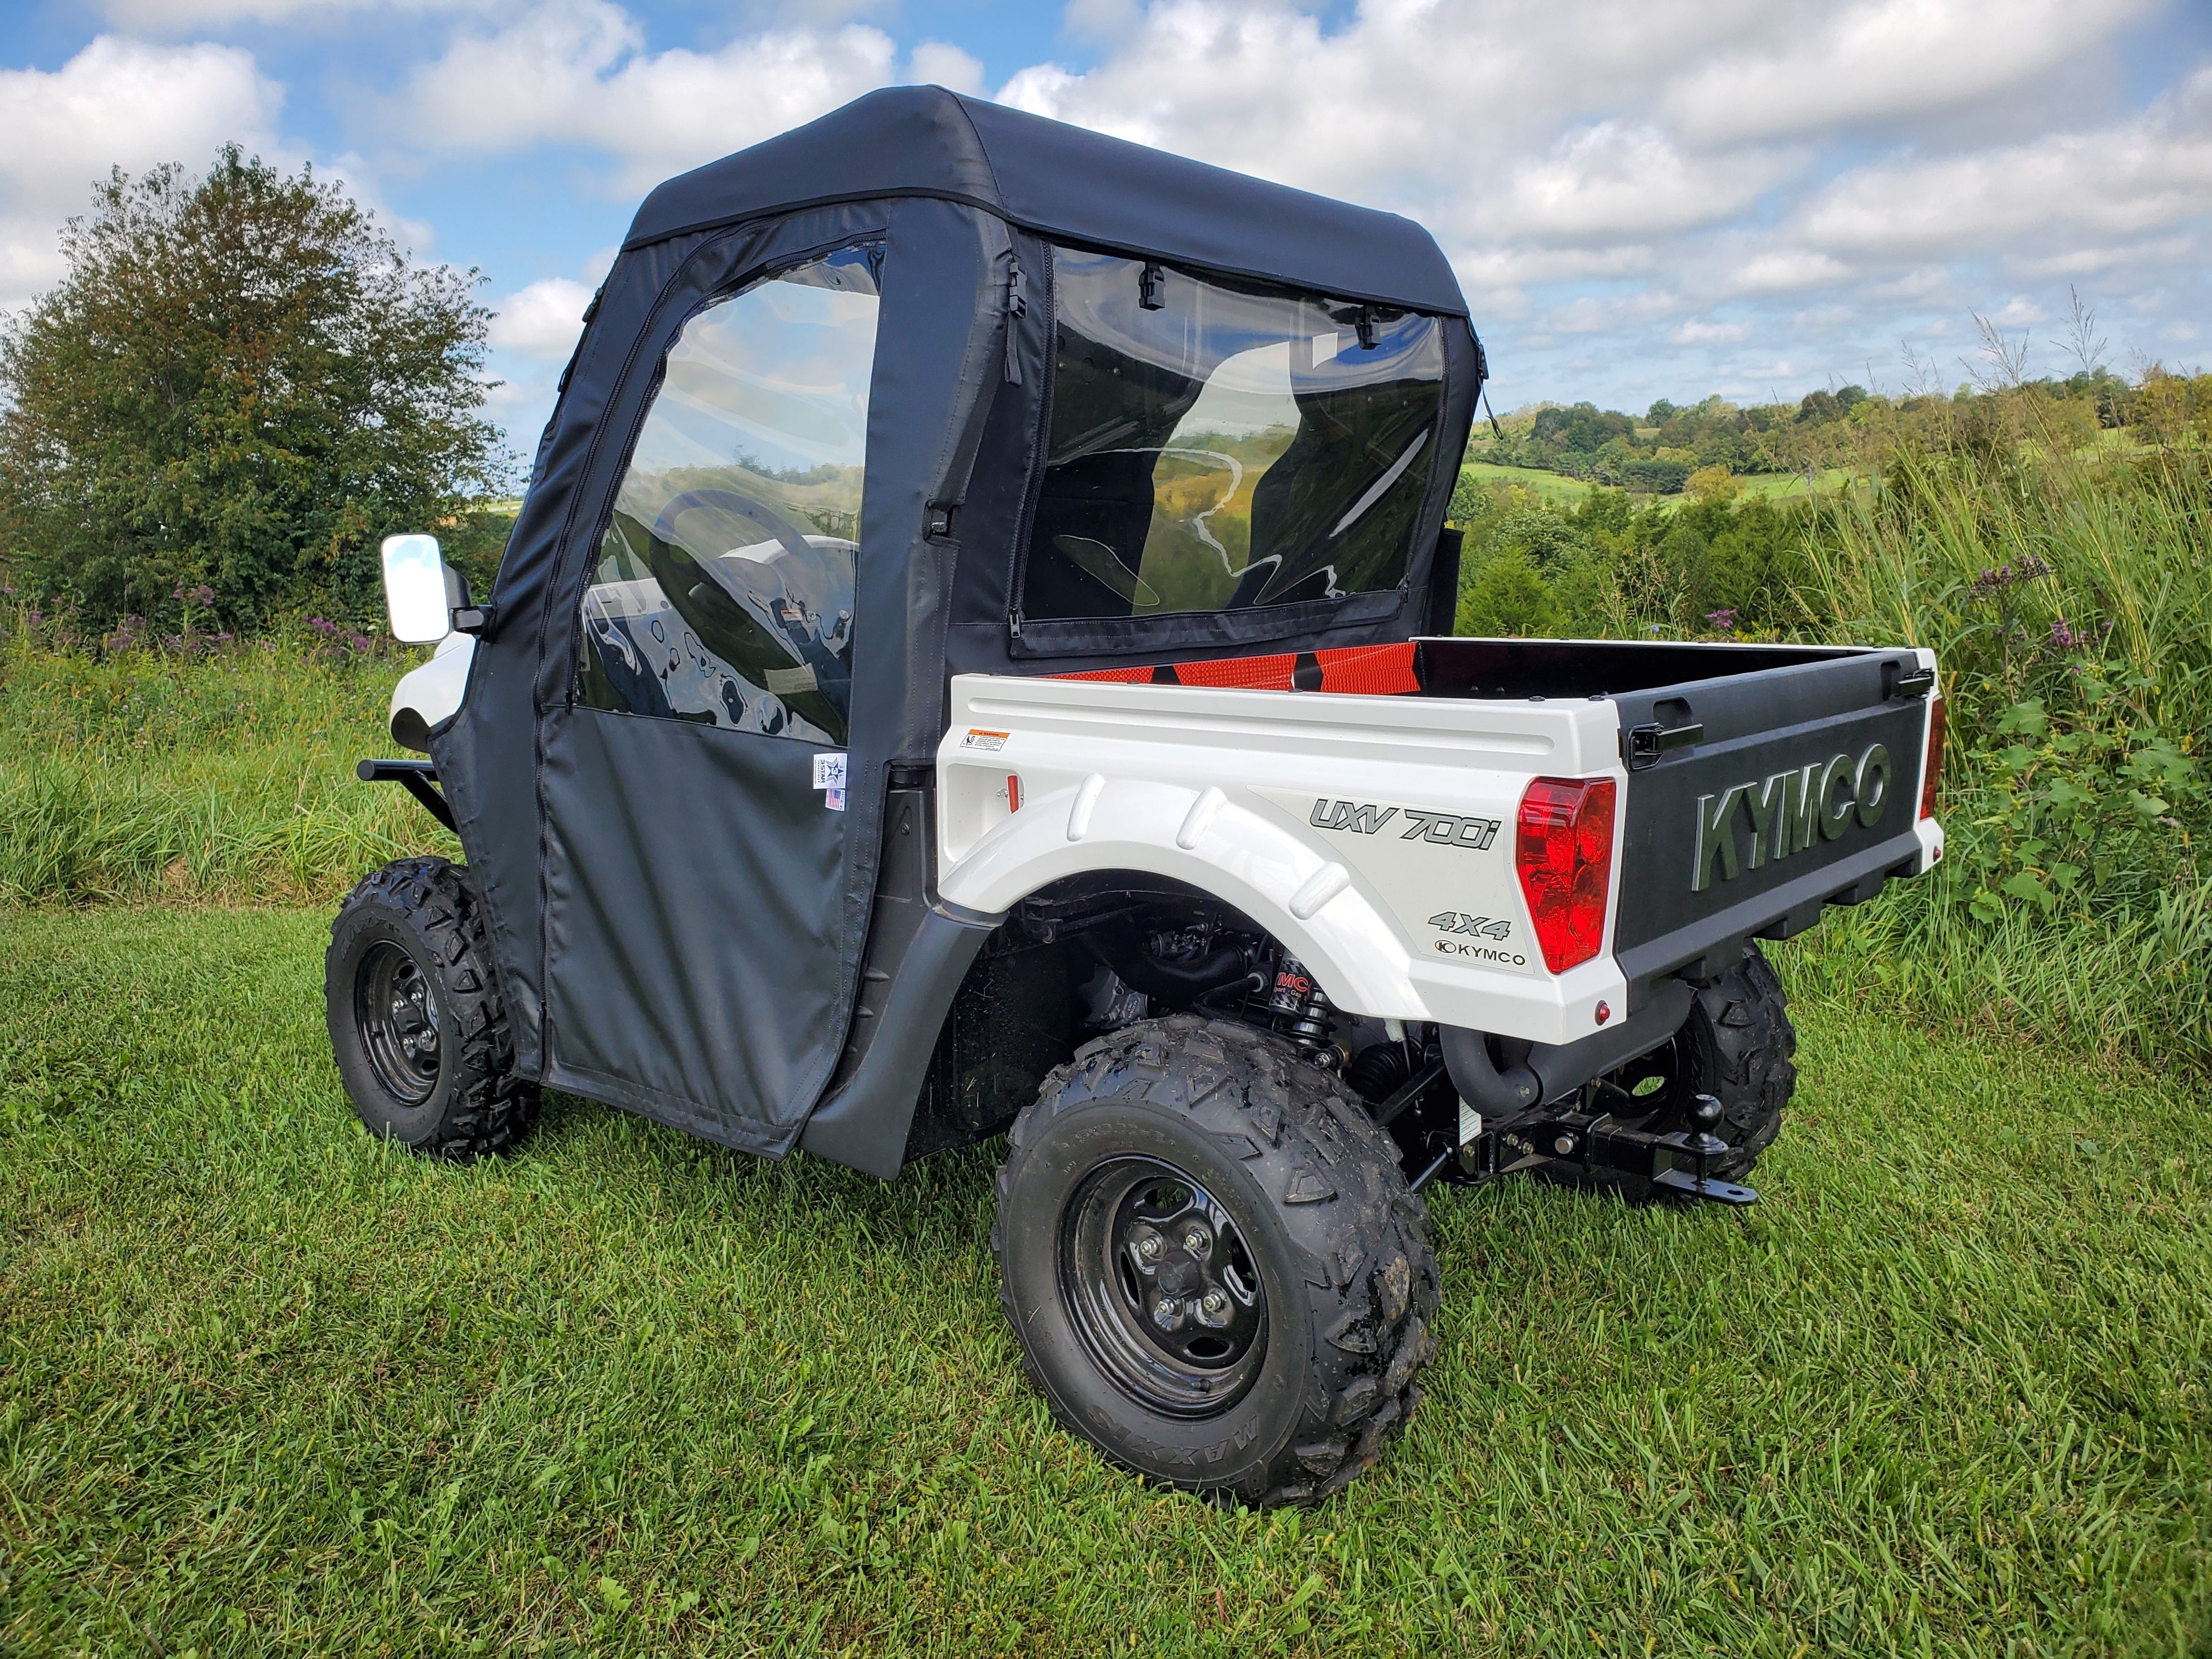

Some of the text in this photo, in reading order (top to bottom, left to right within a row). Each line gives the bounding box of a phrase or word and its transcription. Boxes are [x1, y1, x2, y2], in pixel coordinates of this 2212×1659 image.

[1310, 798, 1502, 851] UXV 700i
[1691, 743, 1891, 891] KYMCO
[1427, 911, 1511, 941] 4X4
[1458, 944, 1526, 966] KYMCO
[1087, 1404, 1258, 1466] MAXXIS
